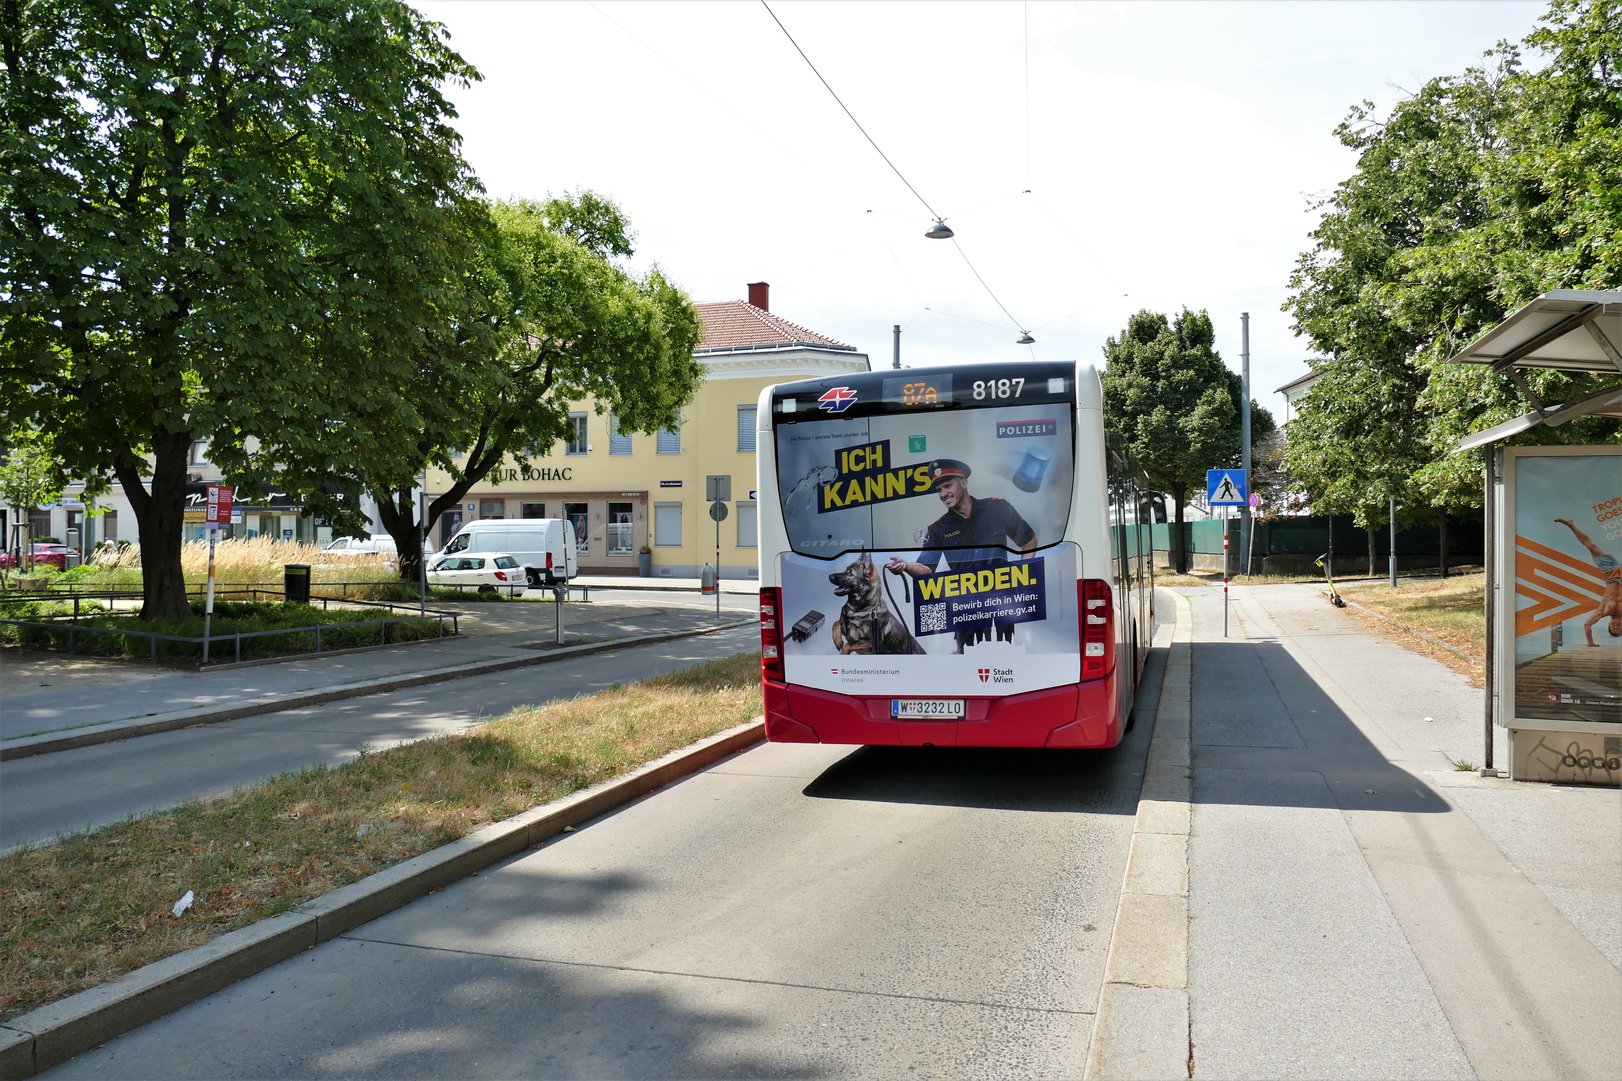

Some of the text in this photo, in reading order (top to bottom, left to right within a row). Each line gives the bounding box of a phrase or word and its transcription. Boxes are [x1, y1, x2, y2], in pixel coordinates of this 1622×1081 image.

[972, 378, 1025, 400] 8187
[999, 425, 1047, 435] POLIZEI
[841, 444, 883, 474] ICH
[823, 465, 932, 509] KANN’S
[799, 538, 864, 547] CITARO
[918, 563, 1037, 600] WERDEN.
[952, 593, 1038, 612] Bewirb dich in Wien:
[952, 604, 1036, 624] polizeikarriere.gv.at
[993, 668, 1013, 676] Stadt
